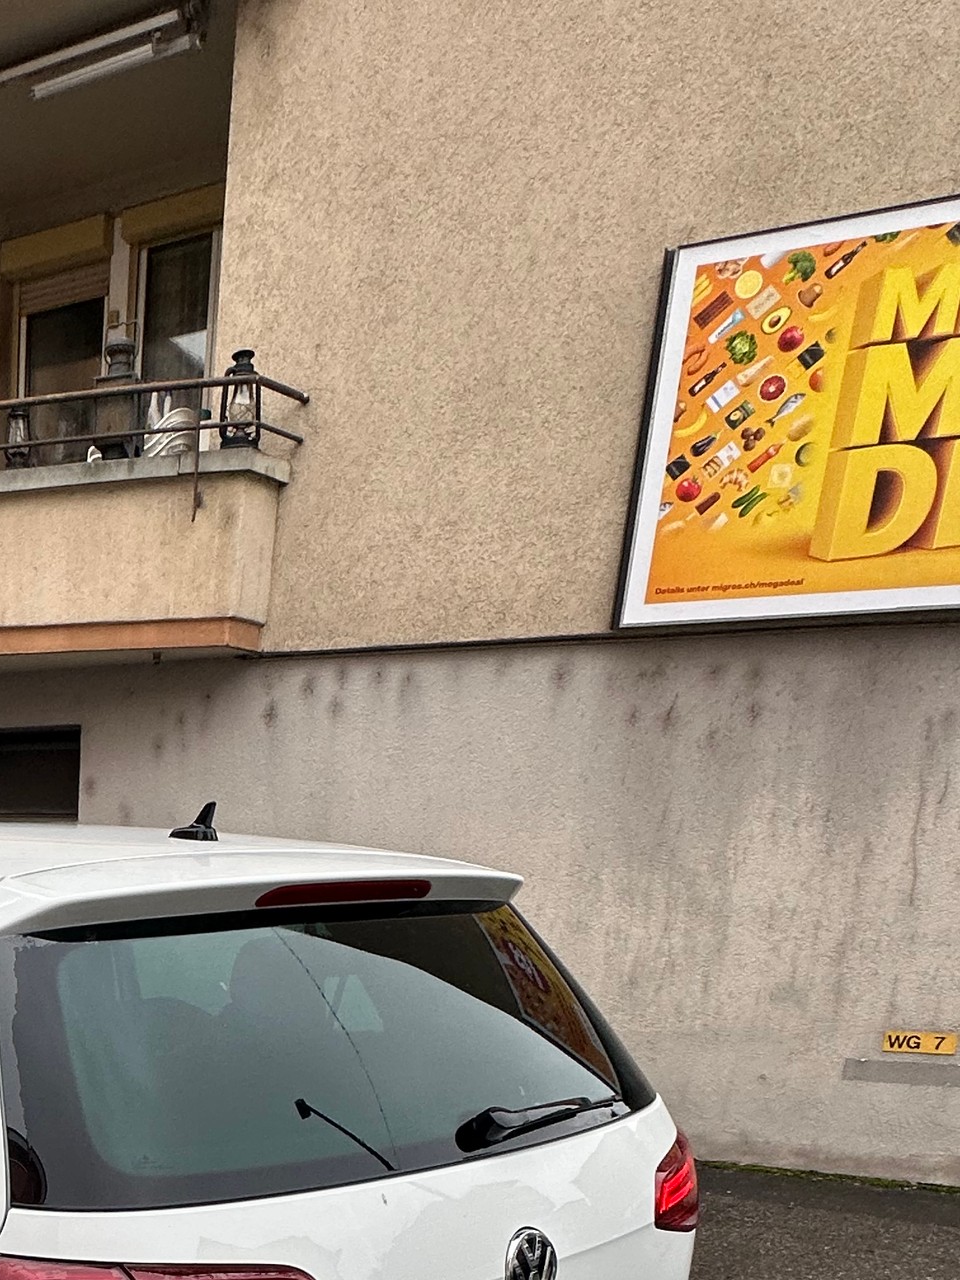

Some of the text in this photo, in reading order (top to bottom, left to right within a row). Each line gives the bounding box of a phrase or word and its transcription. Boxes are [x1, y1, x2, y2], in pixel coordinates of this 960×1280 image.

[655, 578, 805, 595] Details unter migros.ch/megadeal
[887, 1034, 946, 1050] WG 7
